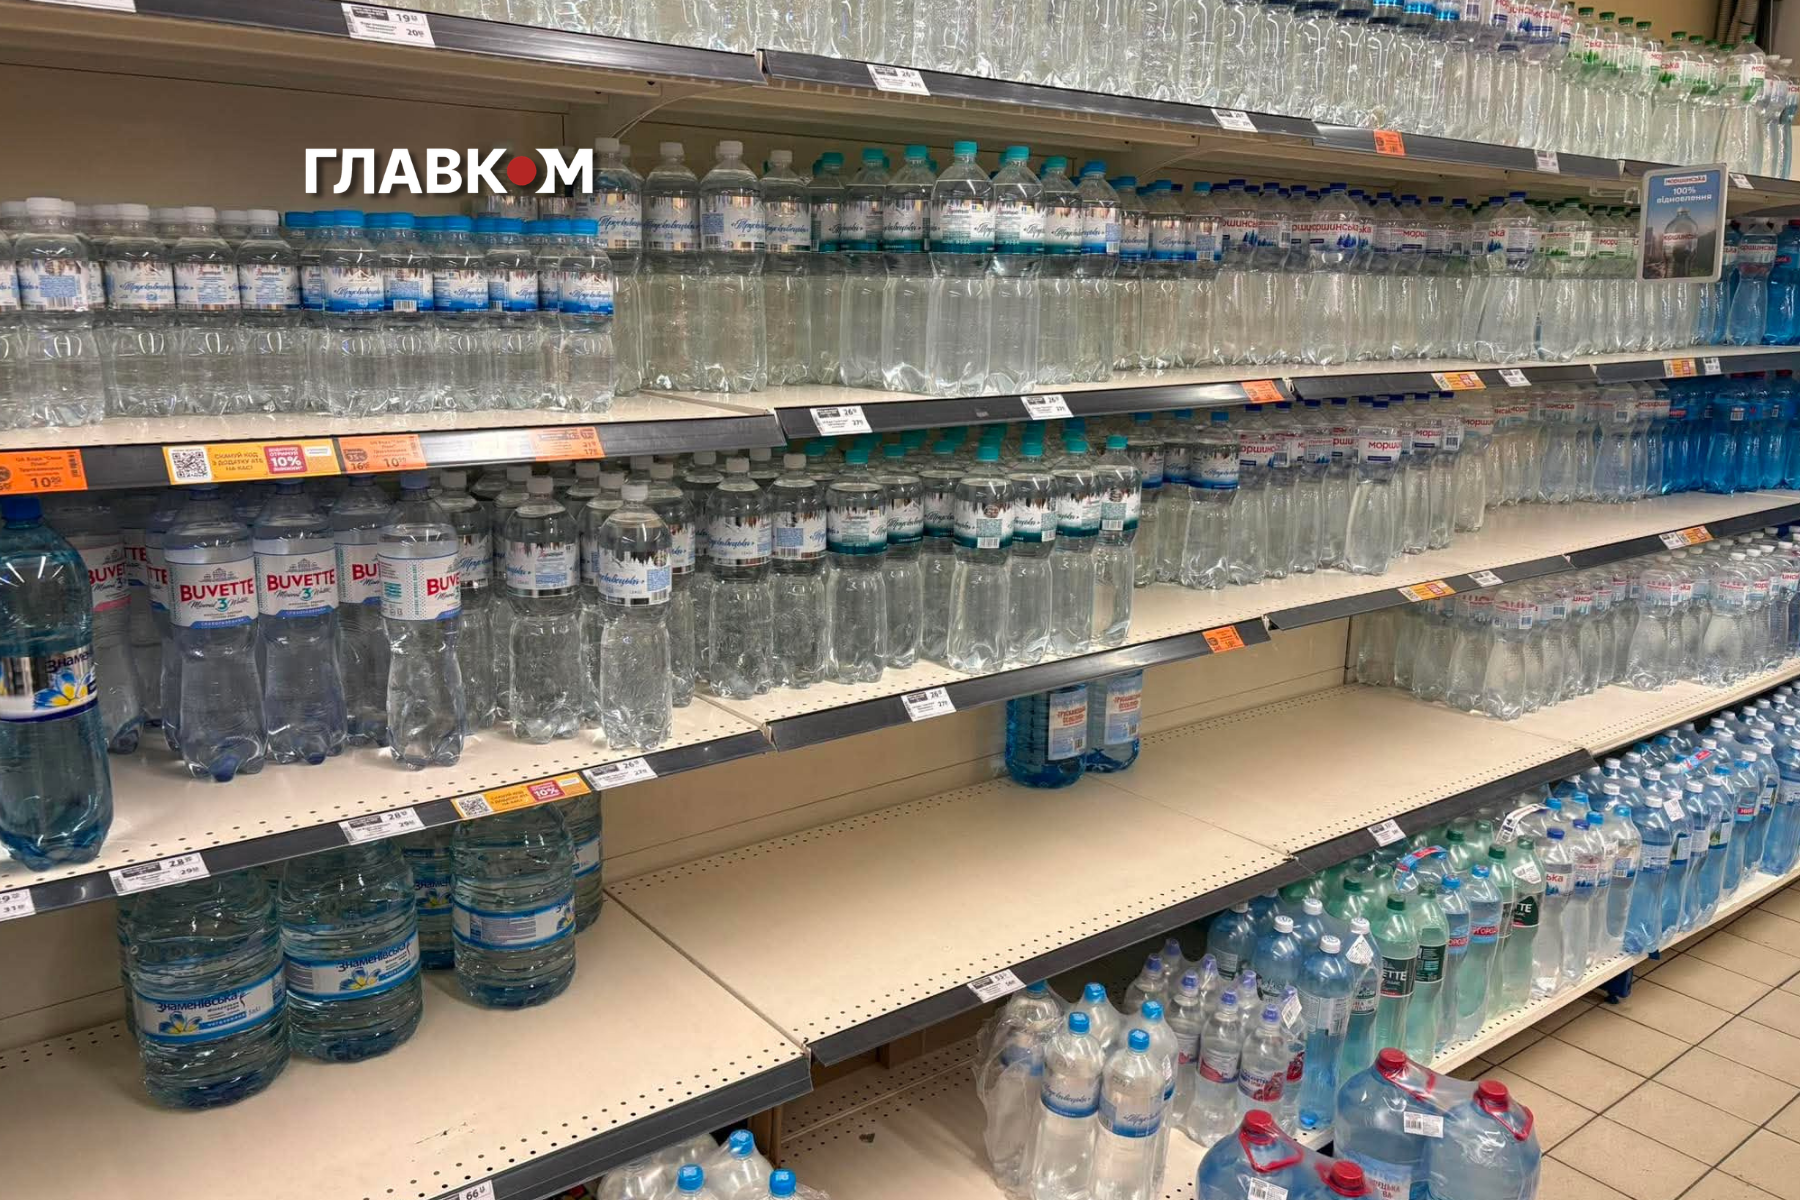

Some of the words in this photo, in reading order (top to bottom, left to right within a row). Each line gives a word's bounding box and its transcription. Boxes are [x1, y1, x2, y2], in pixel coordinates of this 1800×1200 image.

[1673, 187, 1696, 195] 100%
[1657, 194, 1712, 204] відновлення
[270, 457, 302, 467] 10%
[267, 568, 335, 591] BUVETTE
[180, 578, 254, 602] BUVETTE
[300, 588, 313, 600] 3
[190, 599, 216, 609] Mineral
[216, 598, 229, 611] 3
[533, 787, 560, 798] 10%
[157, 992, 239, 1013] Знаменівська
